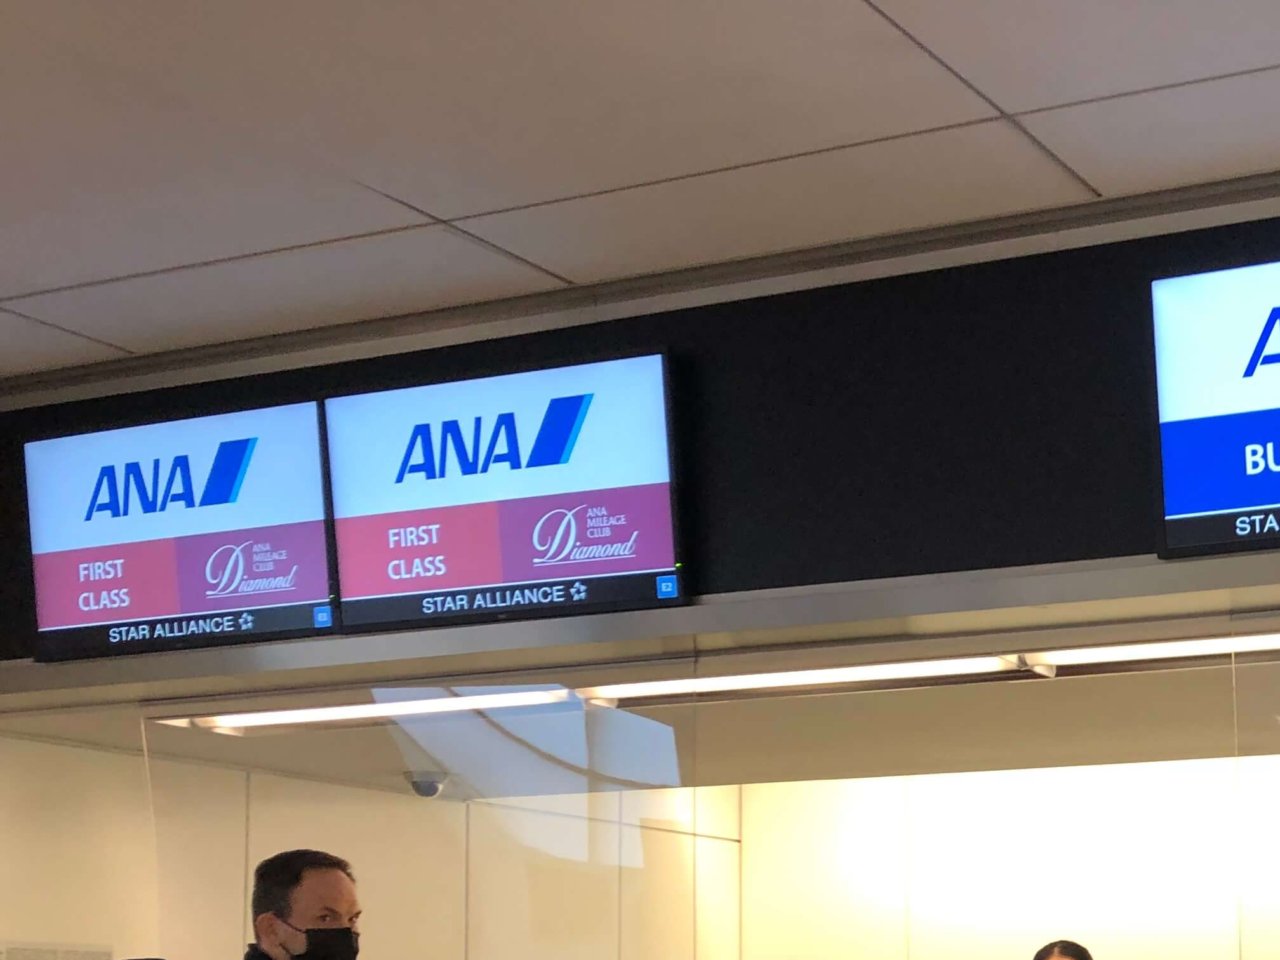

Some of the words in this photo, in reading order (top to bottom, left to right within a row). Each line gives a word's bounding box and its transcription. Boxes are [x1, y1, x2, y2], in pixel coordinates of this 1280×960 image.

[394, 411, 522, 484] ANA
[83, 454, 196, 521] ANA
[586, 506, 608, 518] ANA
[388, 524, 440, 549] FIRST
[532, 504, 640, 562] Diamond
[78, 558, 125, 583] FIRST
[205, 540, 299, 595] Diamond
[387, 555, 447, 580] CLASS
[78, 588, 131, 612] CLASS
[422, 593, 469, 615] STAR
[473, 585, 566, 610] ALLIANCE
[108, 621, 150, 643] STAR
[153, 615, 235, 639] ALLIANCE
